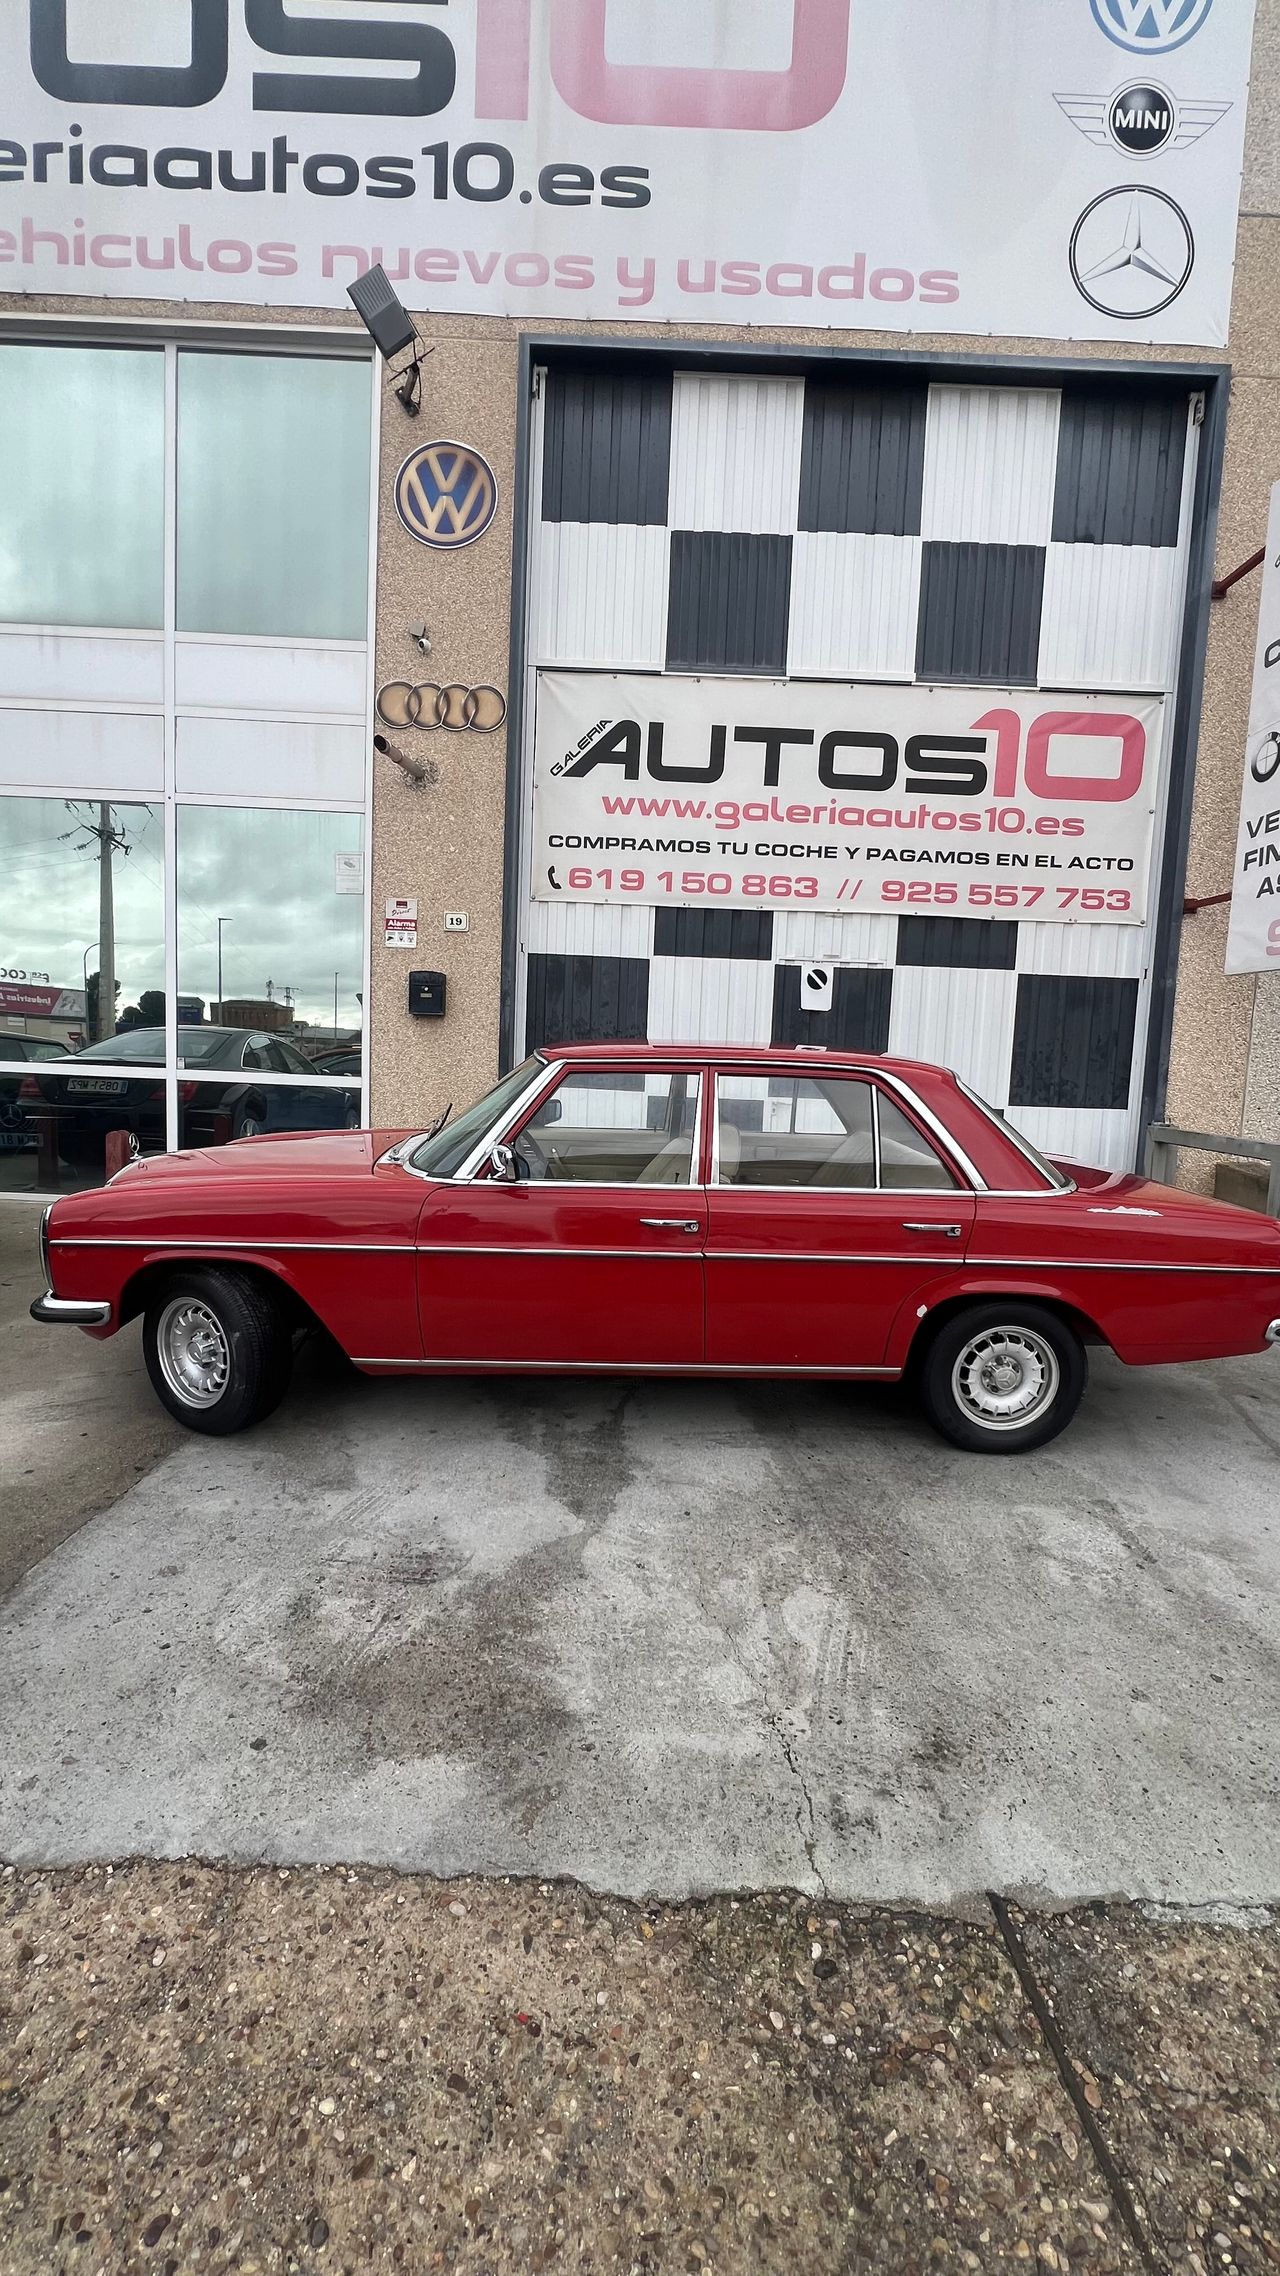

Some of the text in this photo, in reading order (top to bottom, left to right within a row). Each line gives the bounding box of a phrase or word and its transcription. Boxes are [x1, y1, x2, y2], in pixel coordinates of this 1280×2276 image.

[1115, 108, 1168, 130] MINI
[321, 244, 595, 289] nuevos
[616, 257, 655, 307] y
[677, 253, 961, 304] usados
[550, 719, 613, 777] GALERIA
[602, 796, 1085, 837] www.galeriaautos10.es
[548, 835, 1134, 871] COMPRAMOS TU COCHE Y PAGAMOS EN EL ACTO
[568, 867, 645, 891] 619
[657, 871, 732, 894] 150
[741, 874, 818, 898] 863
[881, 880, 959, 904] 925
[968, 884, 1045, 907] 557
[1055, 887, 1132, 911] 753
[1256, 874, 1280, 899] A
[449, 917, 463, 926] 19
